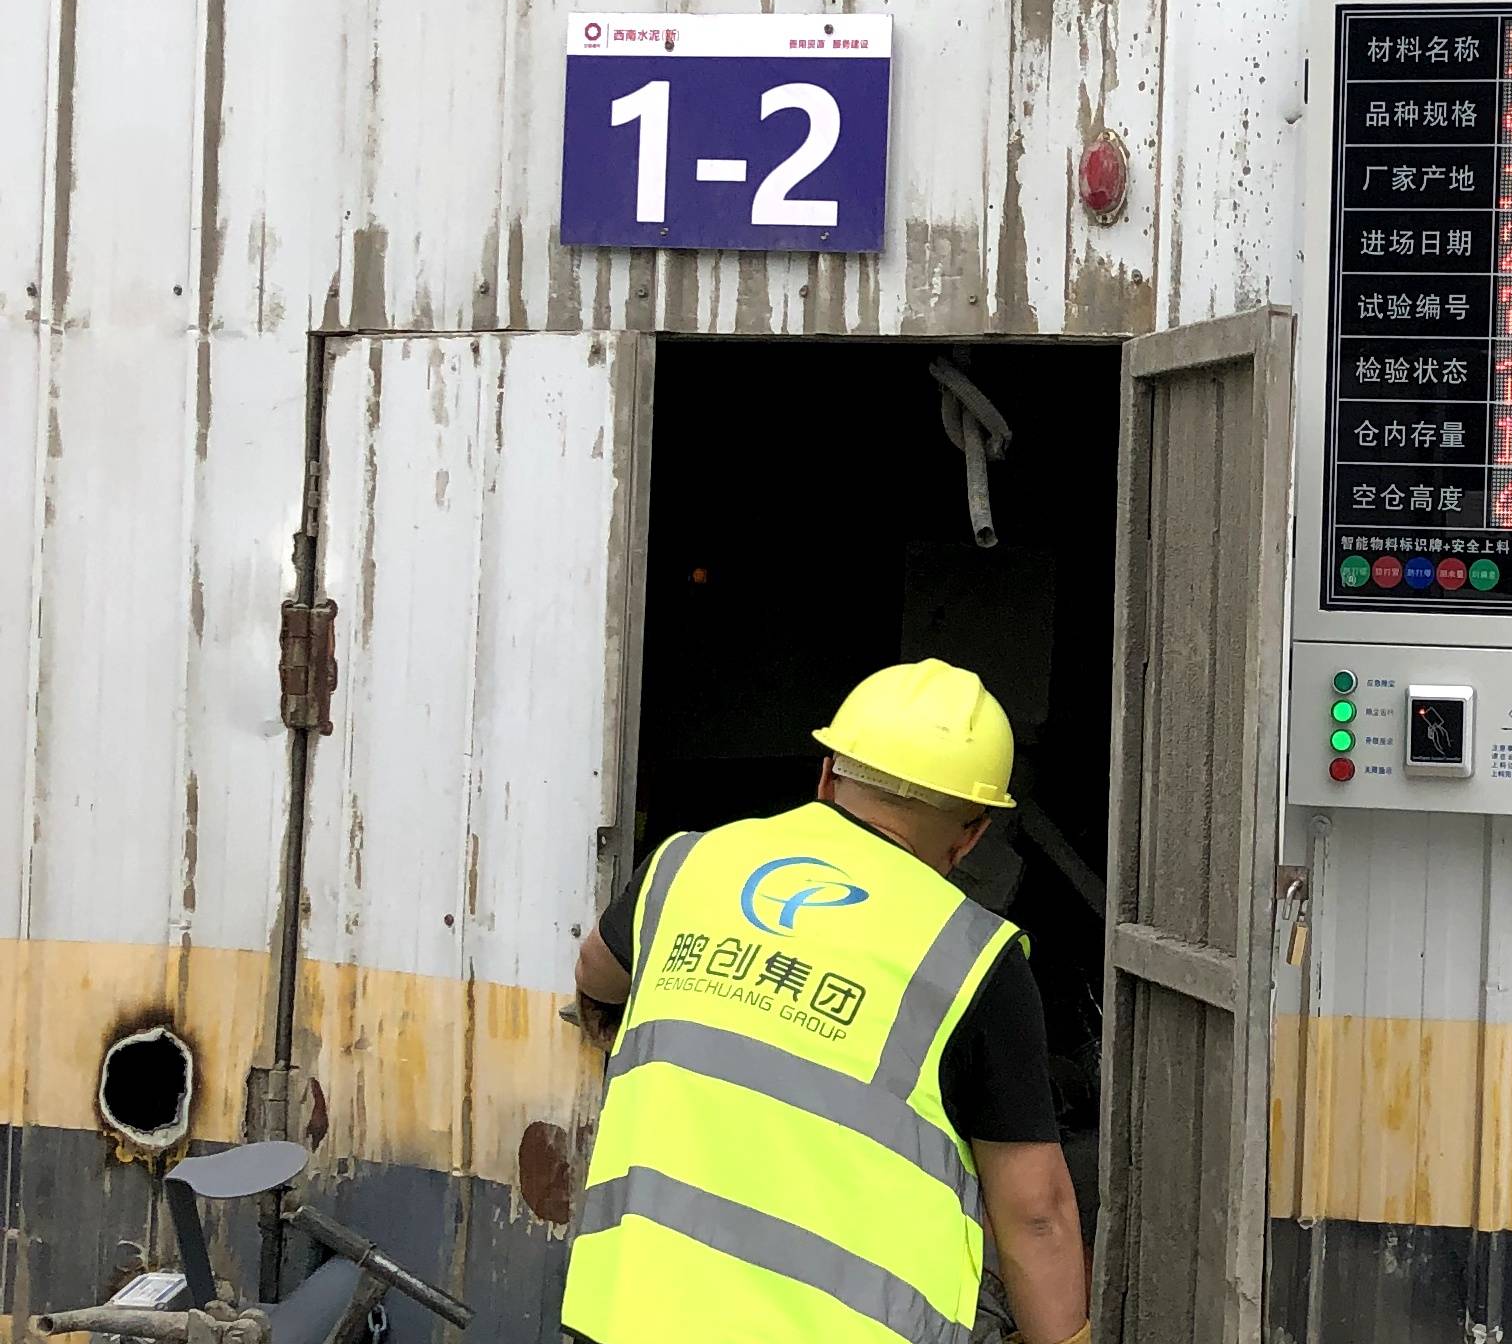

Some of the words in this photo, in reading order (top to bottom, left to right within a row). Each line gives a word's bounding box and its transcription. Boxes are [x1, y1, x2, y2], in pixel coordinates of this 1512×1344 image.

[1367, 35, 1480, 63] 材料名称
[1365, 100, 1478, 128] 品种规格
[611, 80, 842, 227] 1-2
[1362, 164, 1475, 192] 厂家产地
[1360, 229, 1472, 256] 进场日期
[1357, 292, 1470, 320] 试验编号
[1356, 356, 1468, 384] 检验状态
[1354, 419, 1466, 448] 仓内存量
[1352, 483, 1463, 512] 空仓高度
[661, 933, 867, 1027] 鹏创集团
[655, 977, 775, 1012] PENGCHUANG
[779, 1004, 847, 1042] GROUP
